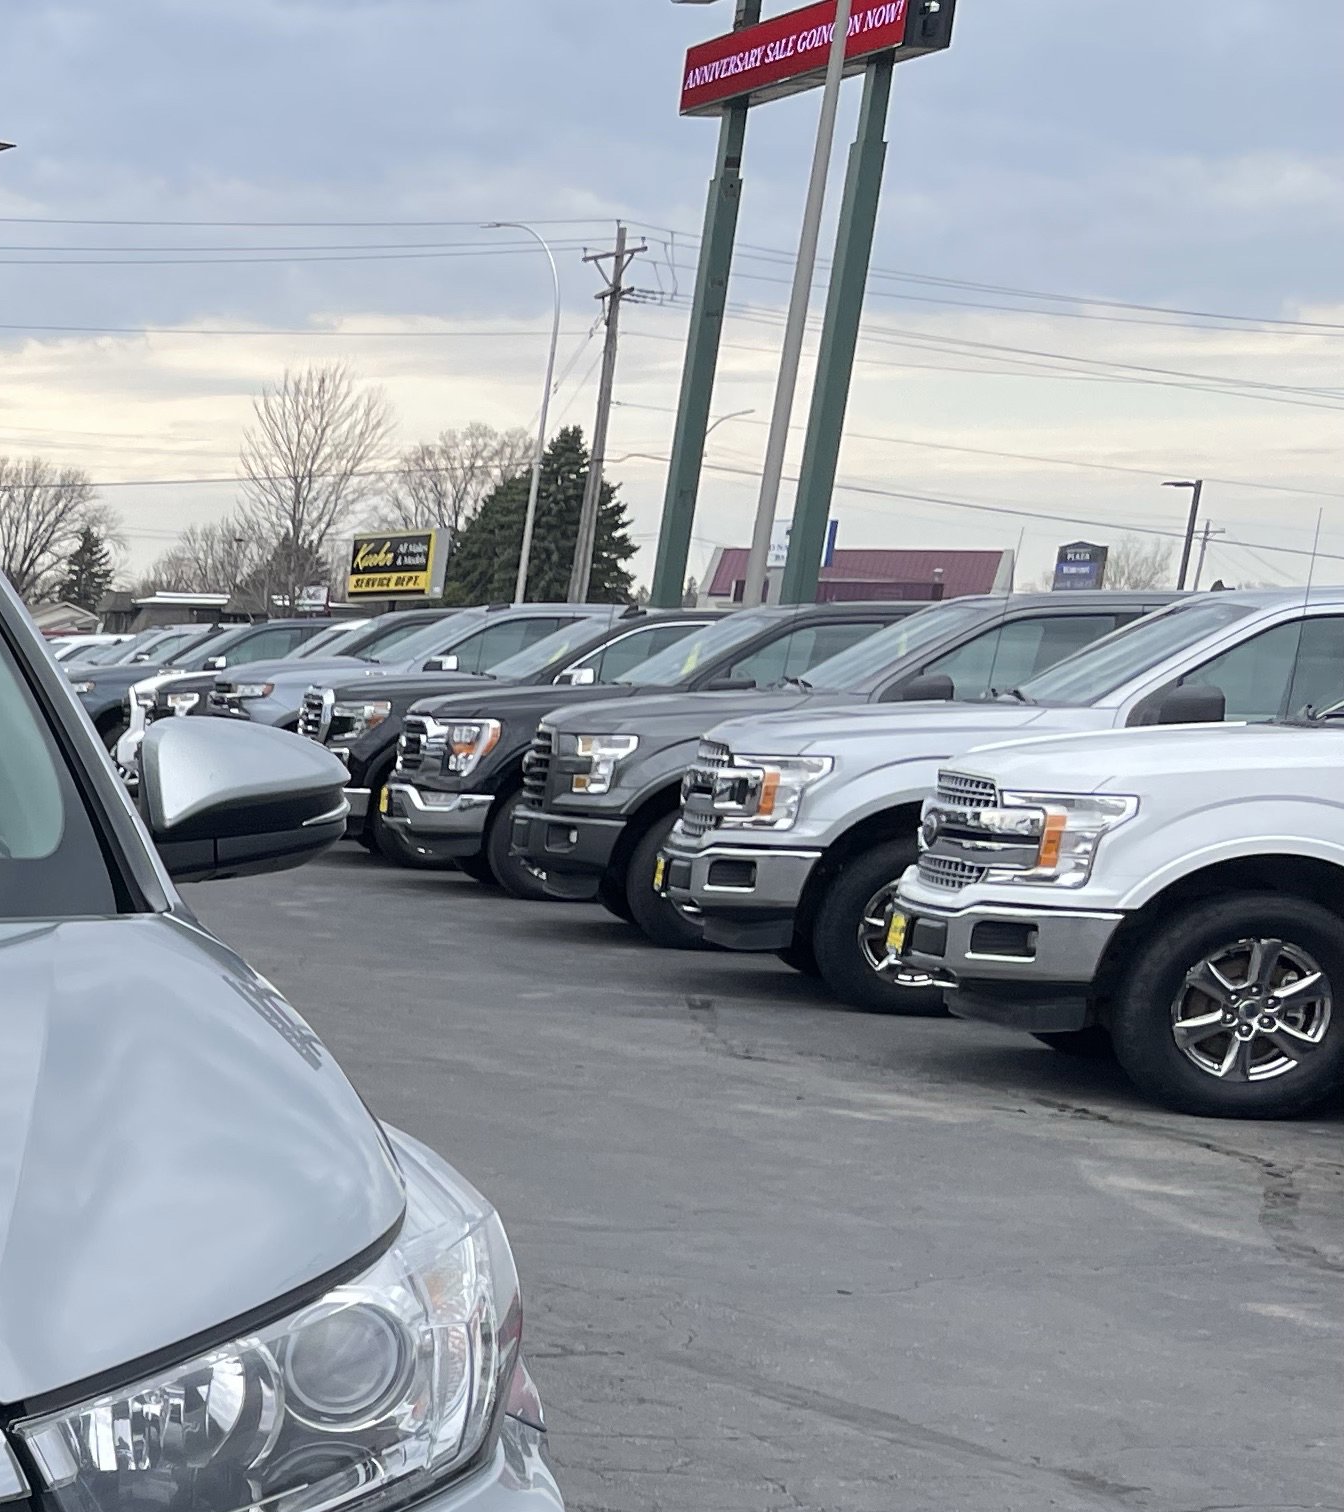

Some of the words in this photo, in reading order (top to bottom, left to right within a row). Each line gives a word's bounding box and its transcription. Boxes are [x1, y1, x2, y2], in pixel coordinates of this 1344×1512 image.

[684, 45, 765, 90] ANNIVERSARY
[764, 35, 797, 64] SALE
[863, 0, 905, 33] NOW!
[353, 541, 395, 570] Kuehn
[354, 575, 392, 589] SERVICE
[394, 575, 420, 587] DEPT.
